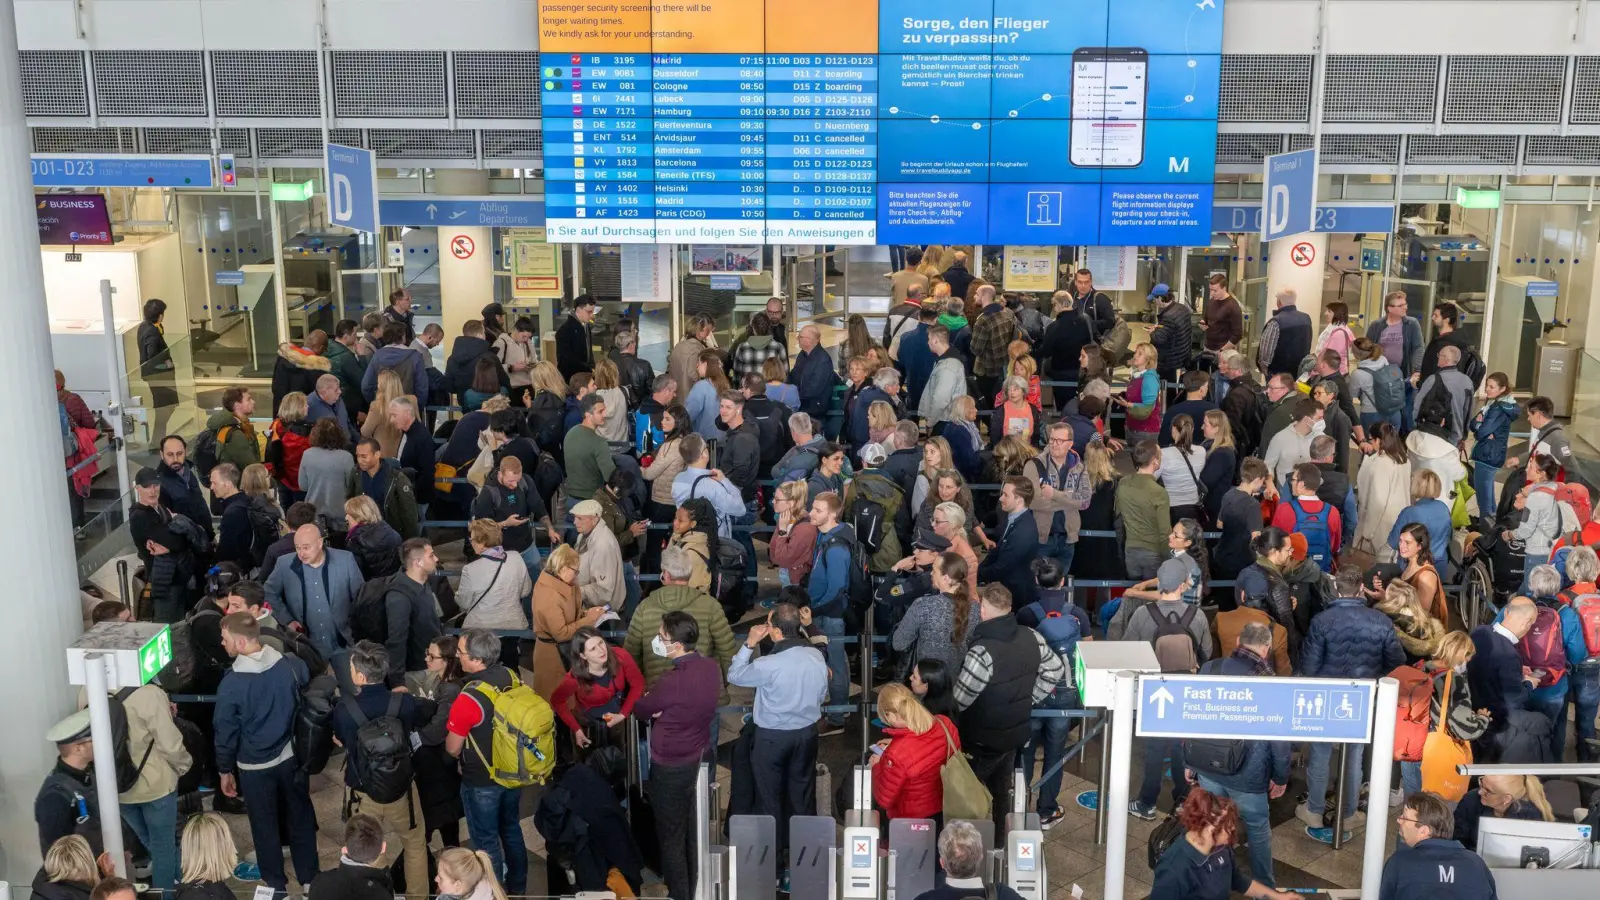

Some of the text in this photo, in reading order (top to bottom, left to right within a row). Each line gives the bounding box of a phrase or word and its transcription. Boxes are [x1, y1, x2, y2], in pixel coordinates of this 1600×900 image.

[586, 4, 618, 13] security
[620, 4, 661, 13] screening
[543, 17, 567, 27] longer
[570, 16, 599, 25] waiting
[904, 17, 1049, 32] Sorge, den Flieger
[559, 30, 583, 39] kindly
[584, 30, 599, 38] ask
[601, 30, 612, 38] for
[614, 31, 632, 39] your
[634, 30, 695, 39] understanding.
[903, 32, 1019, 46] zu verpassen?
[825, 70, 862, 79] boarding
[653, 82, 688, 92] Cologne
[825, 83, 862, 92] boarding
[654, 108, 692, 117] Hamburg
[825, 122, 869, 131] Nuernberg
[654, 134, 696, 143] Arvidsjaur
[331, 151, 355, 164] Terminal
[1168, 157, 1189, 173] M
[1273, 159, 1297, 172] Terminal
[692, 171, 715, 180] (TFS)
[333, 173, 352, 221] D
[480, 202, 508, 214] Abflug
[1112, 201, 1129, 209] flight
[1270, 184, 1289, 234] D
[479, 214, 528, 225] Departures
[680, 210, 706, 218] (CDG)
[1232, 208, 1246, 228] D
[79, 232, 100, 241] Priority
[559, 226, 864, 239] Sie auf Durchsagen und folgen Sie den Anweisungen
[1184, 687, 1253, 701] Fast Track
[1183, 703, 1258, 713] First, Business and
[1182, 712, 1284, 724] Premium Passengers only
[1438, 864, 1455, 884] M
